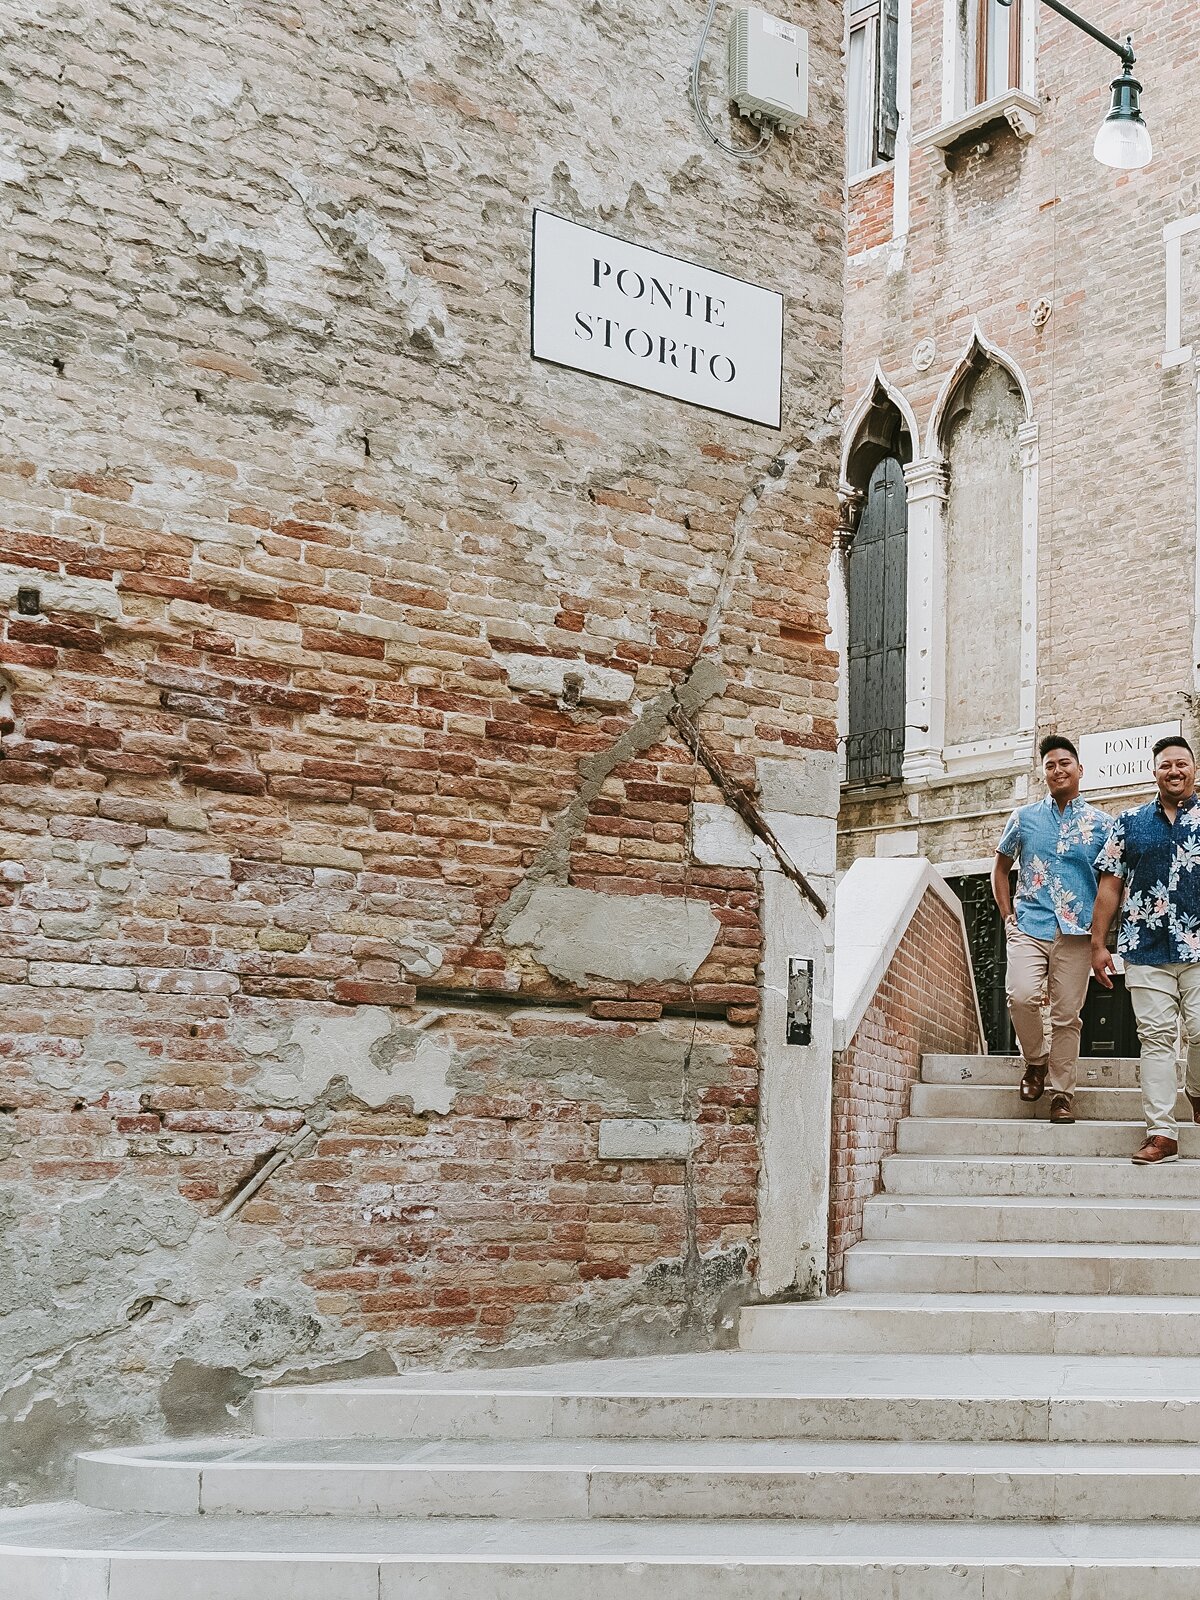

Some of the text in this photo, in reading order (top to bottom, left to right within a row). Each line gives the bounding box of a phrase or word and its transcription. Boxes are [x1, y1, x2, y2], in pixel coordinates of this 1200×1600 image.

[592, 258, 726, 328] PONTE
[574, 311, 737, 383] STORTO
[1105, 735, 1153, 755] PONTE
